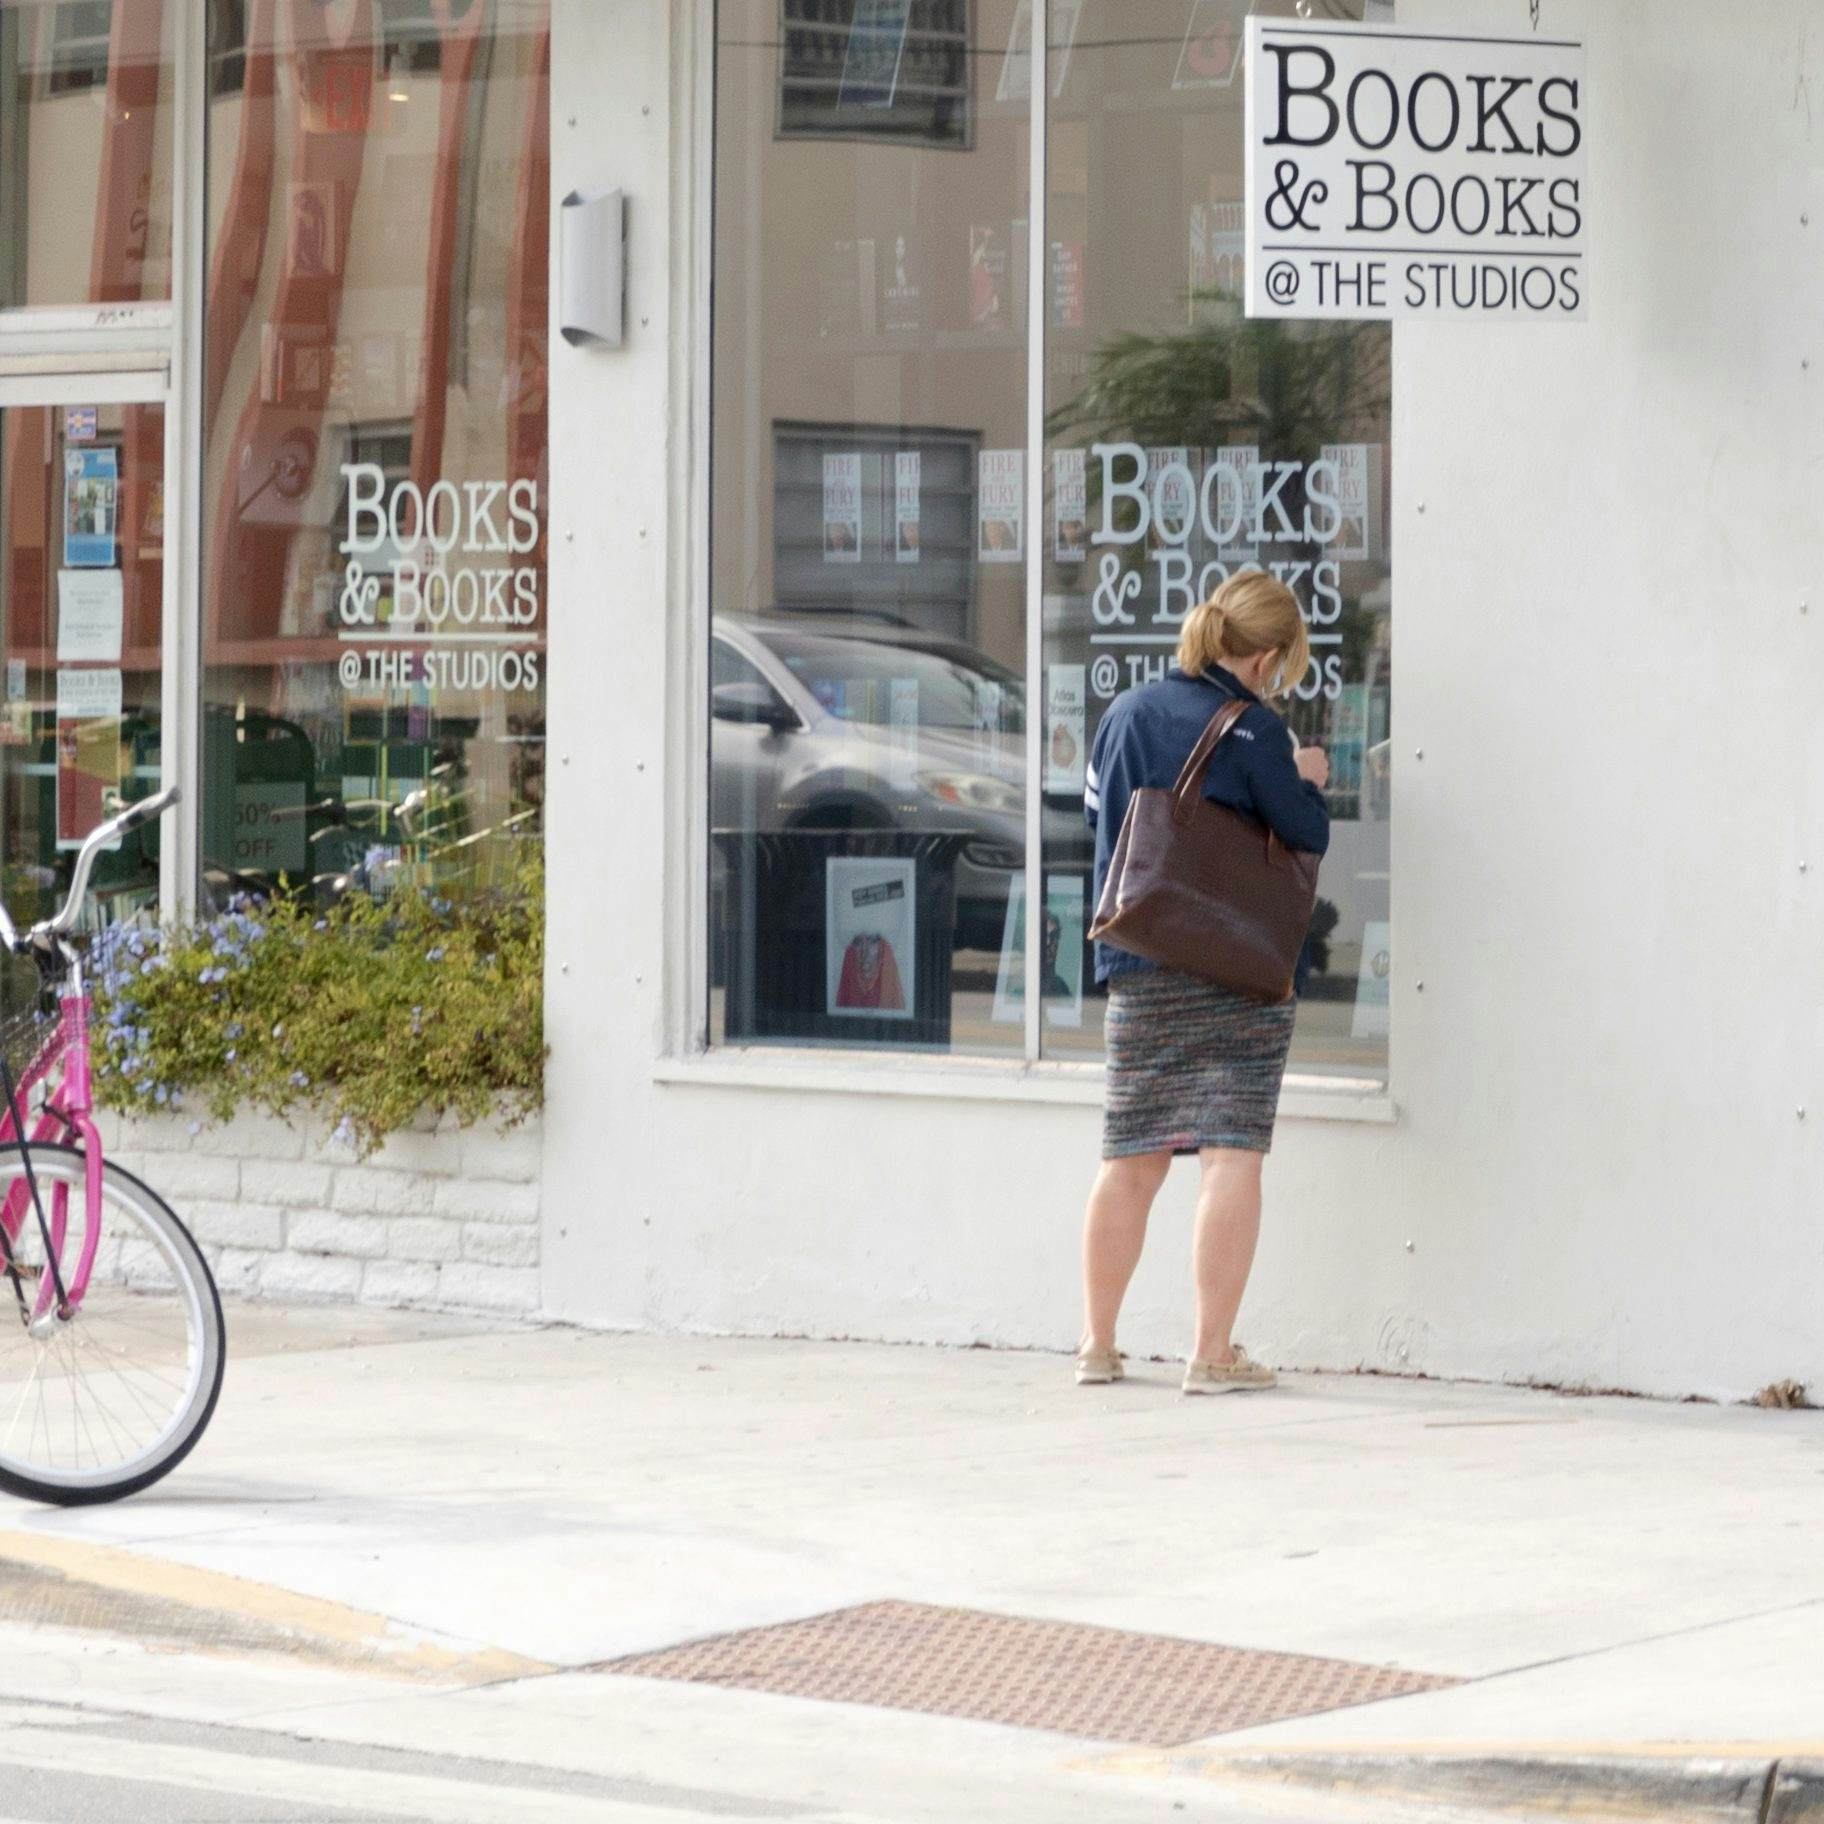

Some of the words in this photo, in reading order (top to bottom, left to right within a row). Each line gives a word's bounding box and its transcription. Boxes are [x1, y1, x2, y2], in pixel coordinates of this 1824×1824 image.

[1262, 42, 1582, 158] BOOKS
[1264, 159, 1329, 232] &
[1344, 160, 1582, 239] BOOKS
[1265, 259, 1300, 305] @
[1310, 261, 1387, 307] THE
[1404, 262, 1581, 312] STUDIOS
[982, 454, 1015, 473] FIRE
[982, 485, 1015, 505] FURY
[1090, 441, 1343, 545] BOOKS
[338, 463, 539, 555] BOOKS
[339, 560, 381, 625] &
[386, 560, 538, 626] BOOKS
[1091, 553, 1142, 625] &
[338, 650, 363, 691] @
[366, 652, 413, 689] THE
[422, 650, 539, 691] STUDIOS
[1091, 654, 1120, 699] @
